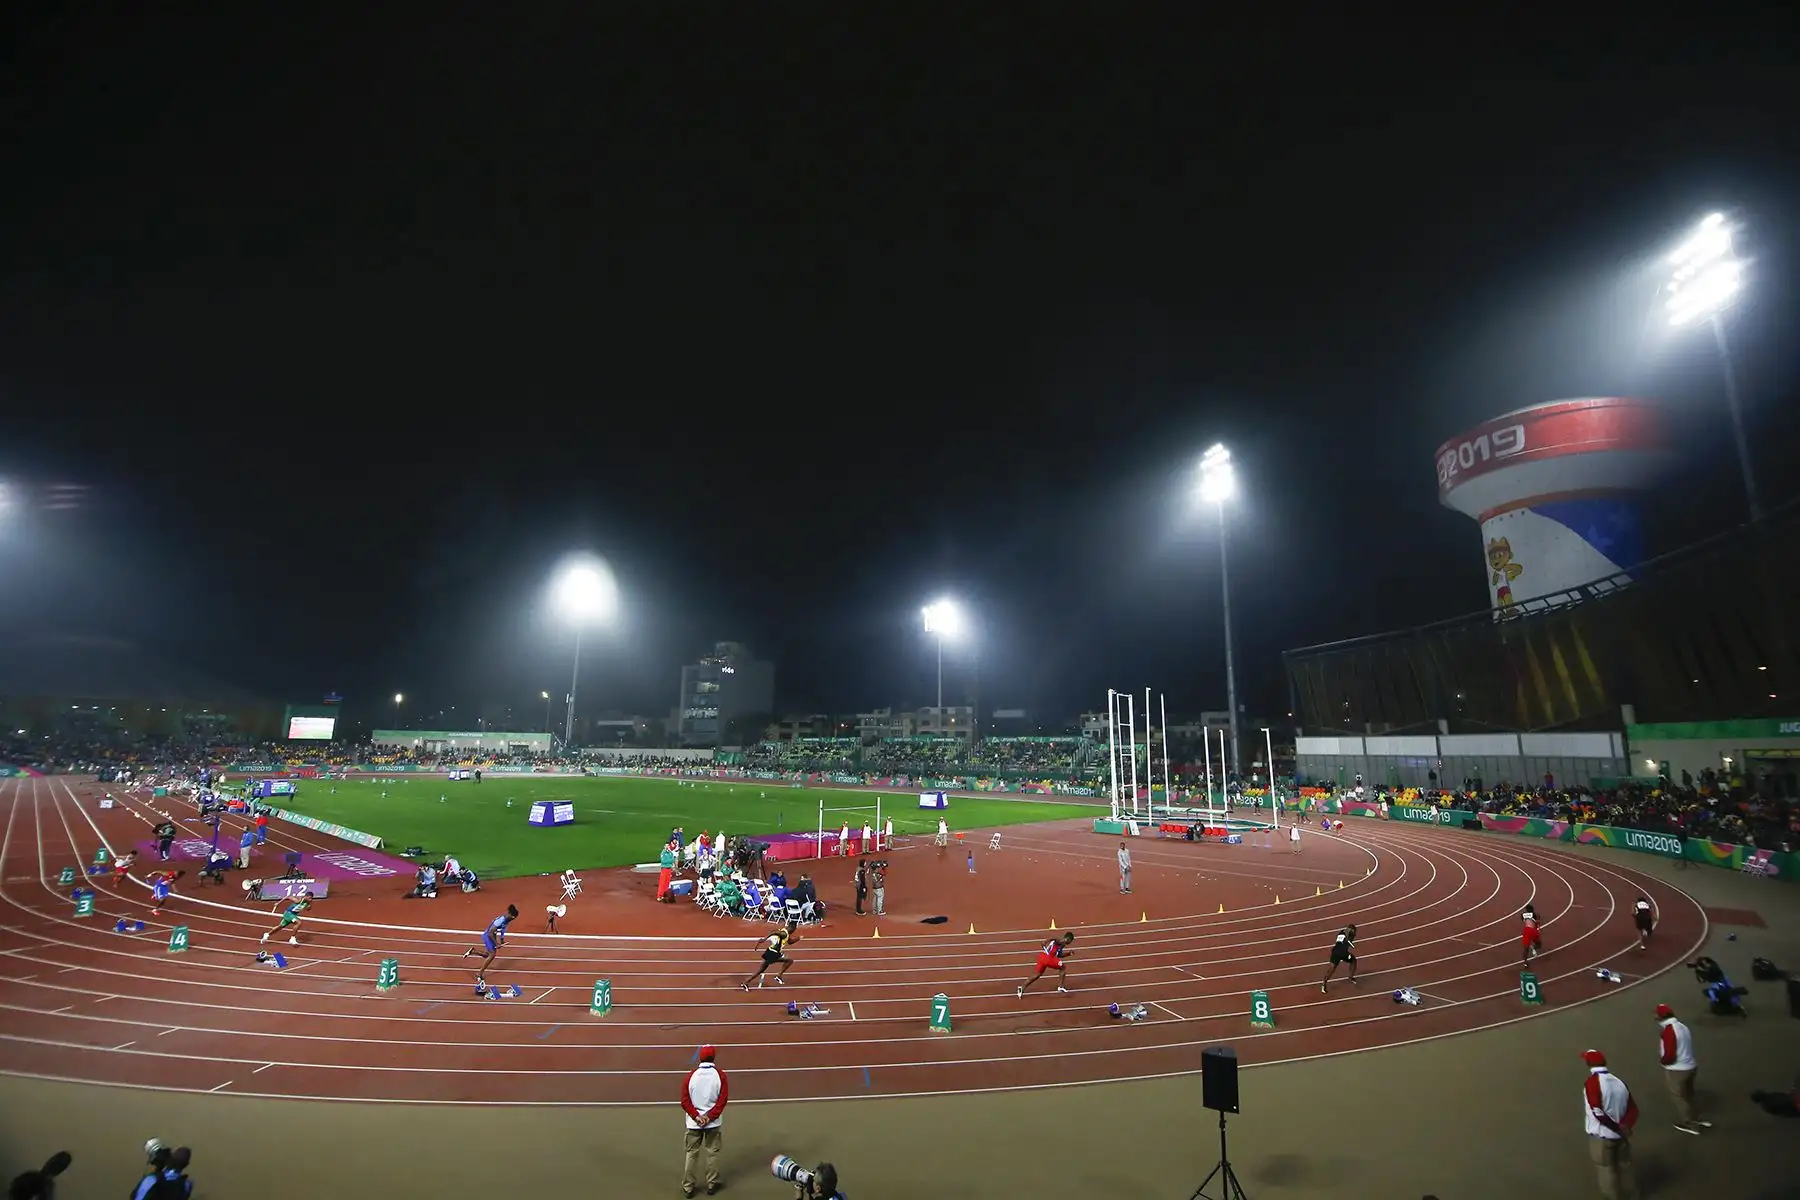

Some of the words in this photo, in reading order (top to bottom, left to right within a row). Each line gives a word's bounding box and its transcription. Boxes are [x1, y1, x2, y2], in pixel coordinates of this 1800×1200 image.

[78, 900, 90, 912] 3
[174, 933, 186, 946] 4
[379, 967, 387, 983] 5
[389, 966, 397, 983] 5
[594, 989, 603, 1007] 6
[604, 988, 610, 1006] 6
[1525, 982, 1536, 998] 9
[935, 1005, 947, 1023] 7
[1255, 1001, 1268, 1018] 8
